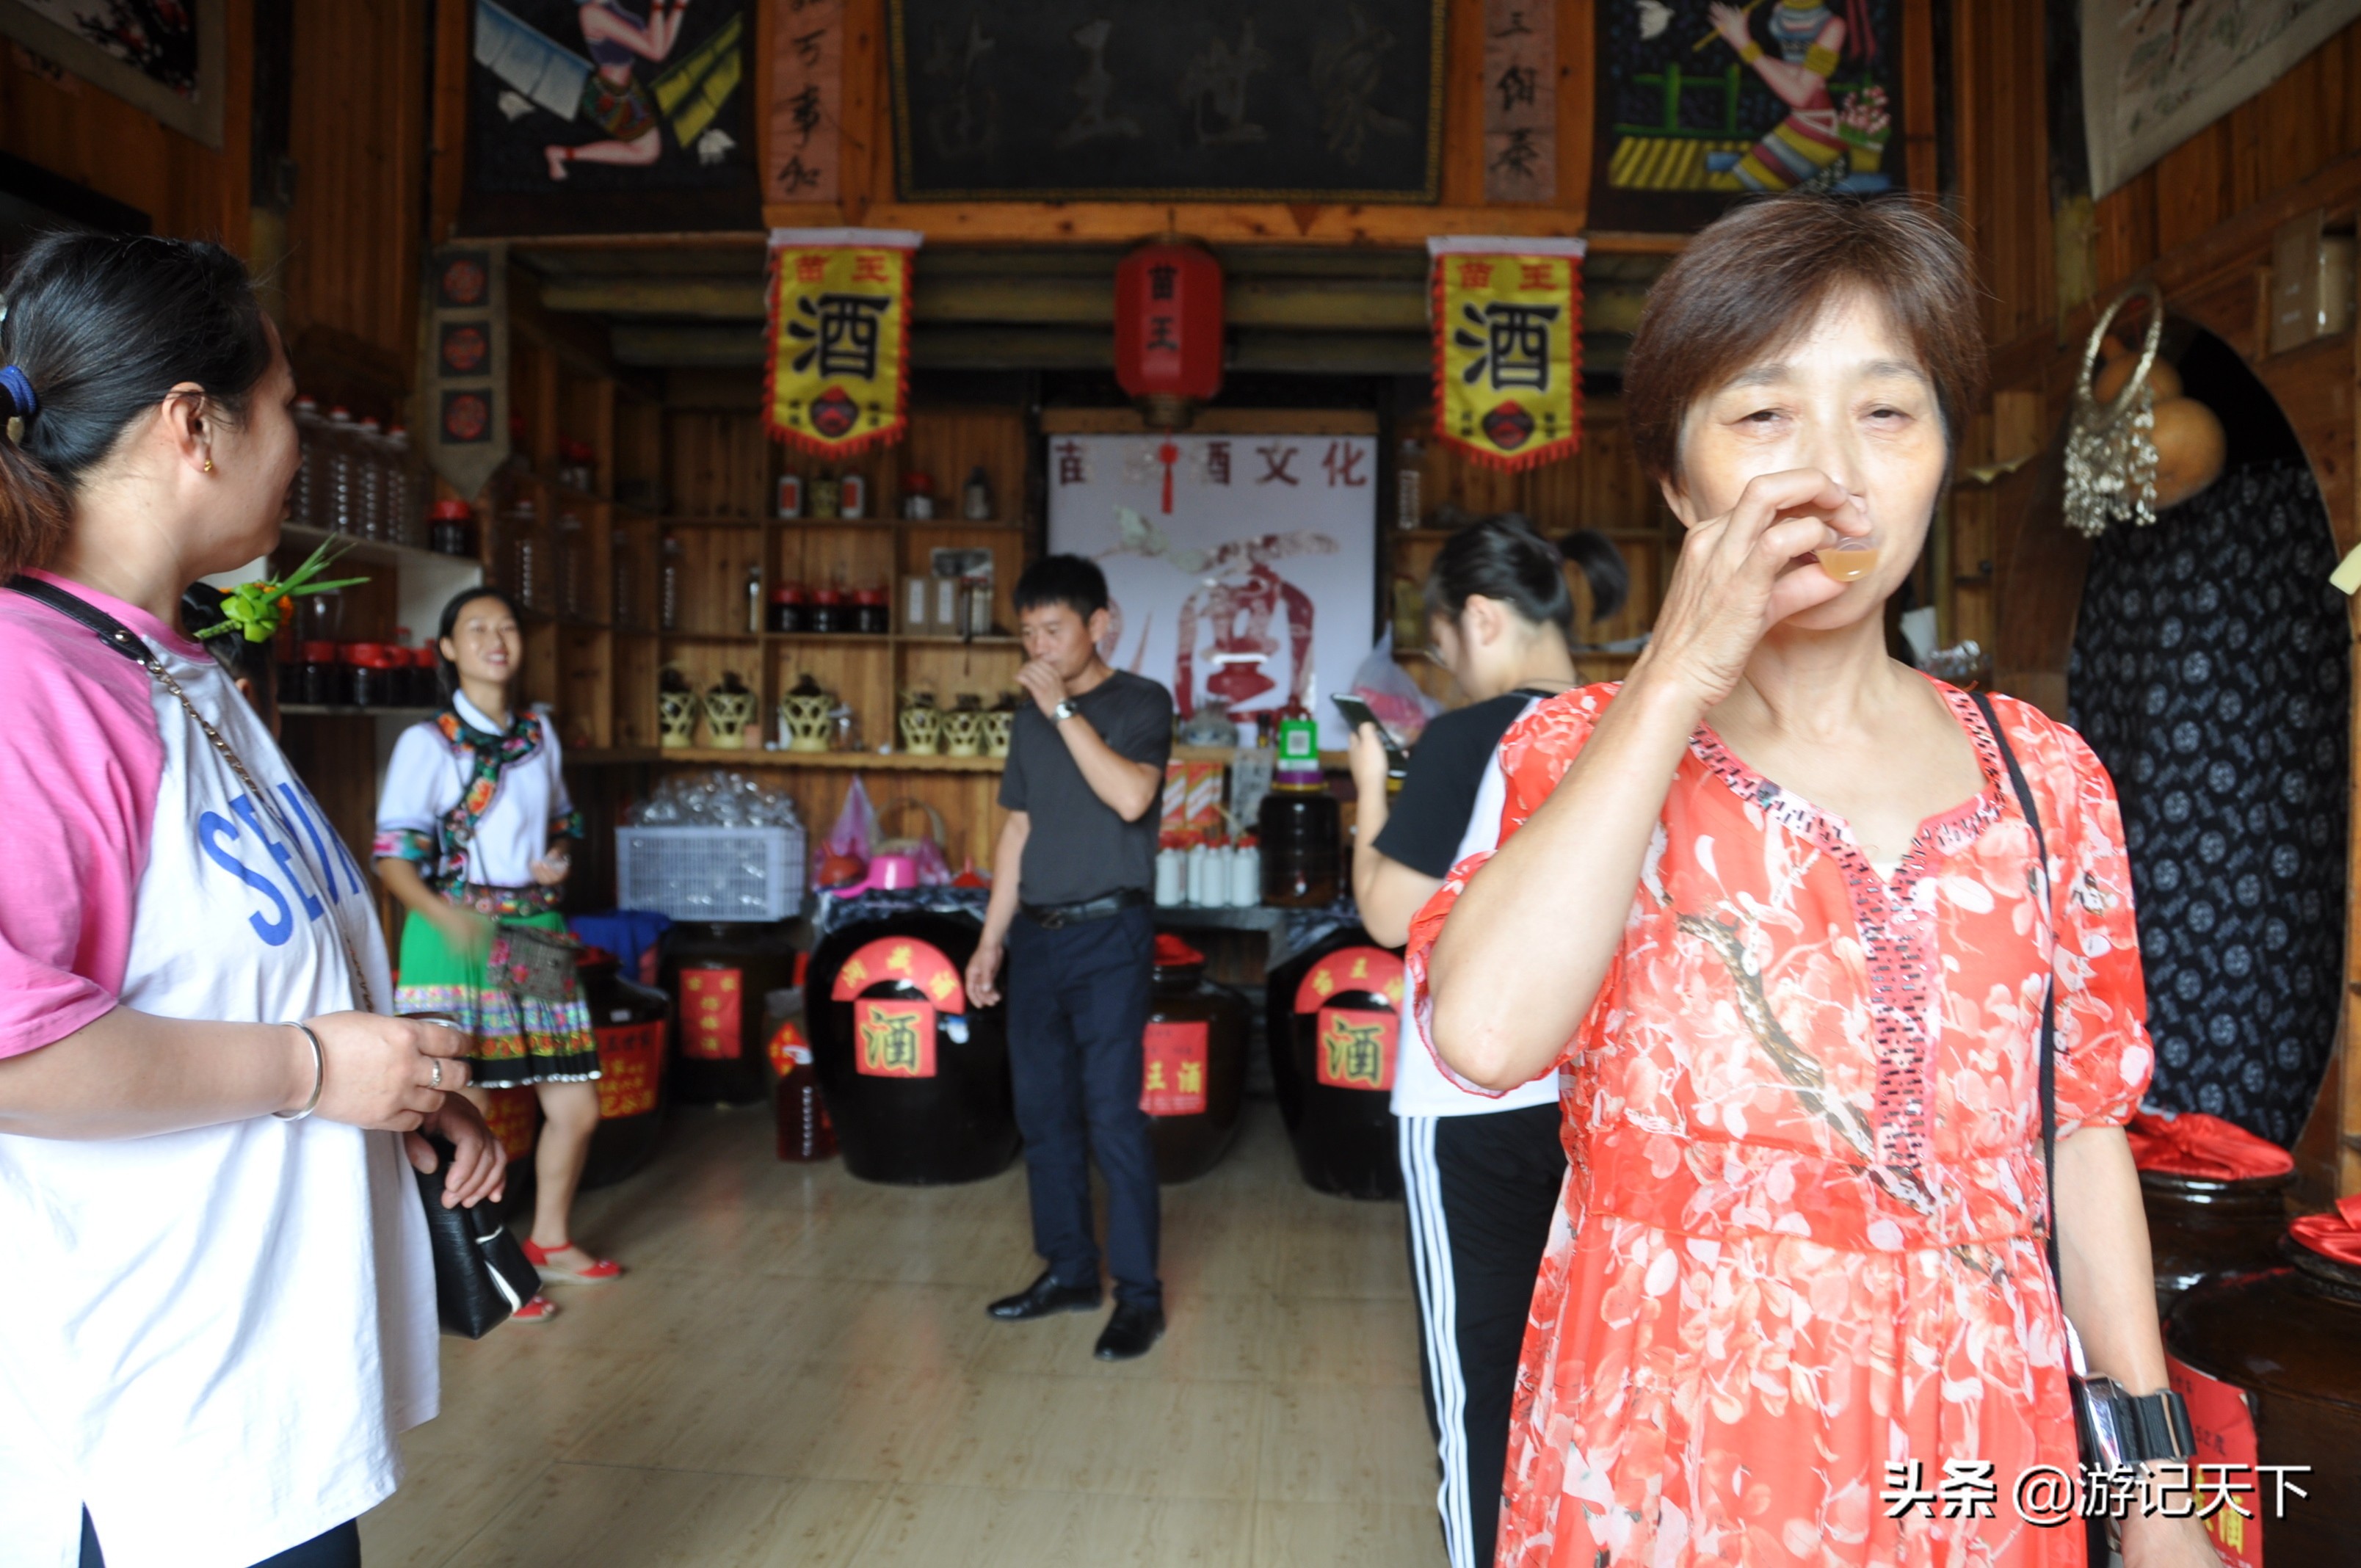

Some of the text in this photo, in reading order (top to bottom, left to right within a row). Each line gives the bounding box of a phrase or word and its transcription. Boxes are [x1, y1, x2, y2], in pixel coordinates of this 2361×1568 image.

[792, 255, 890, 283] 苗王
[1457, 262, 1559, 291] 苗王
[786, 292, 891, 382] 酒
[1146, 264, 1179, 351] 苗王
[1454, 301, 1561, 393] 酒
[860, 1003, 921, 1075] 酒
[1322, 1013, 1385, 1089] 酒
